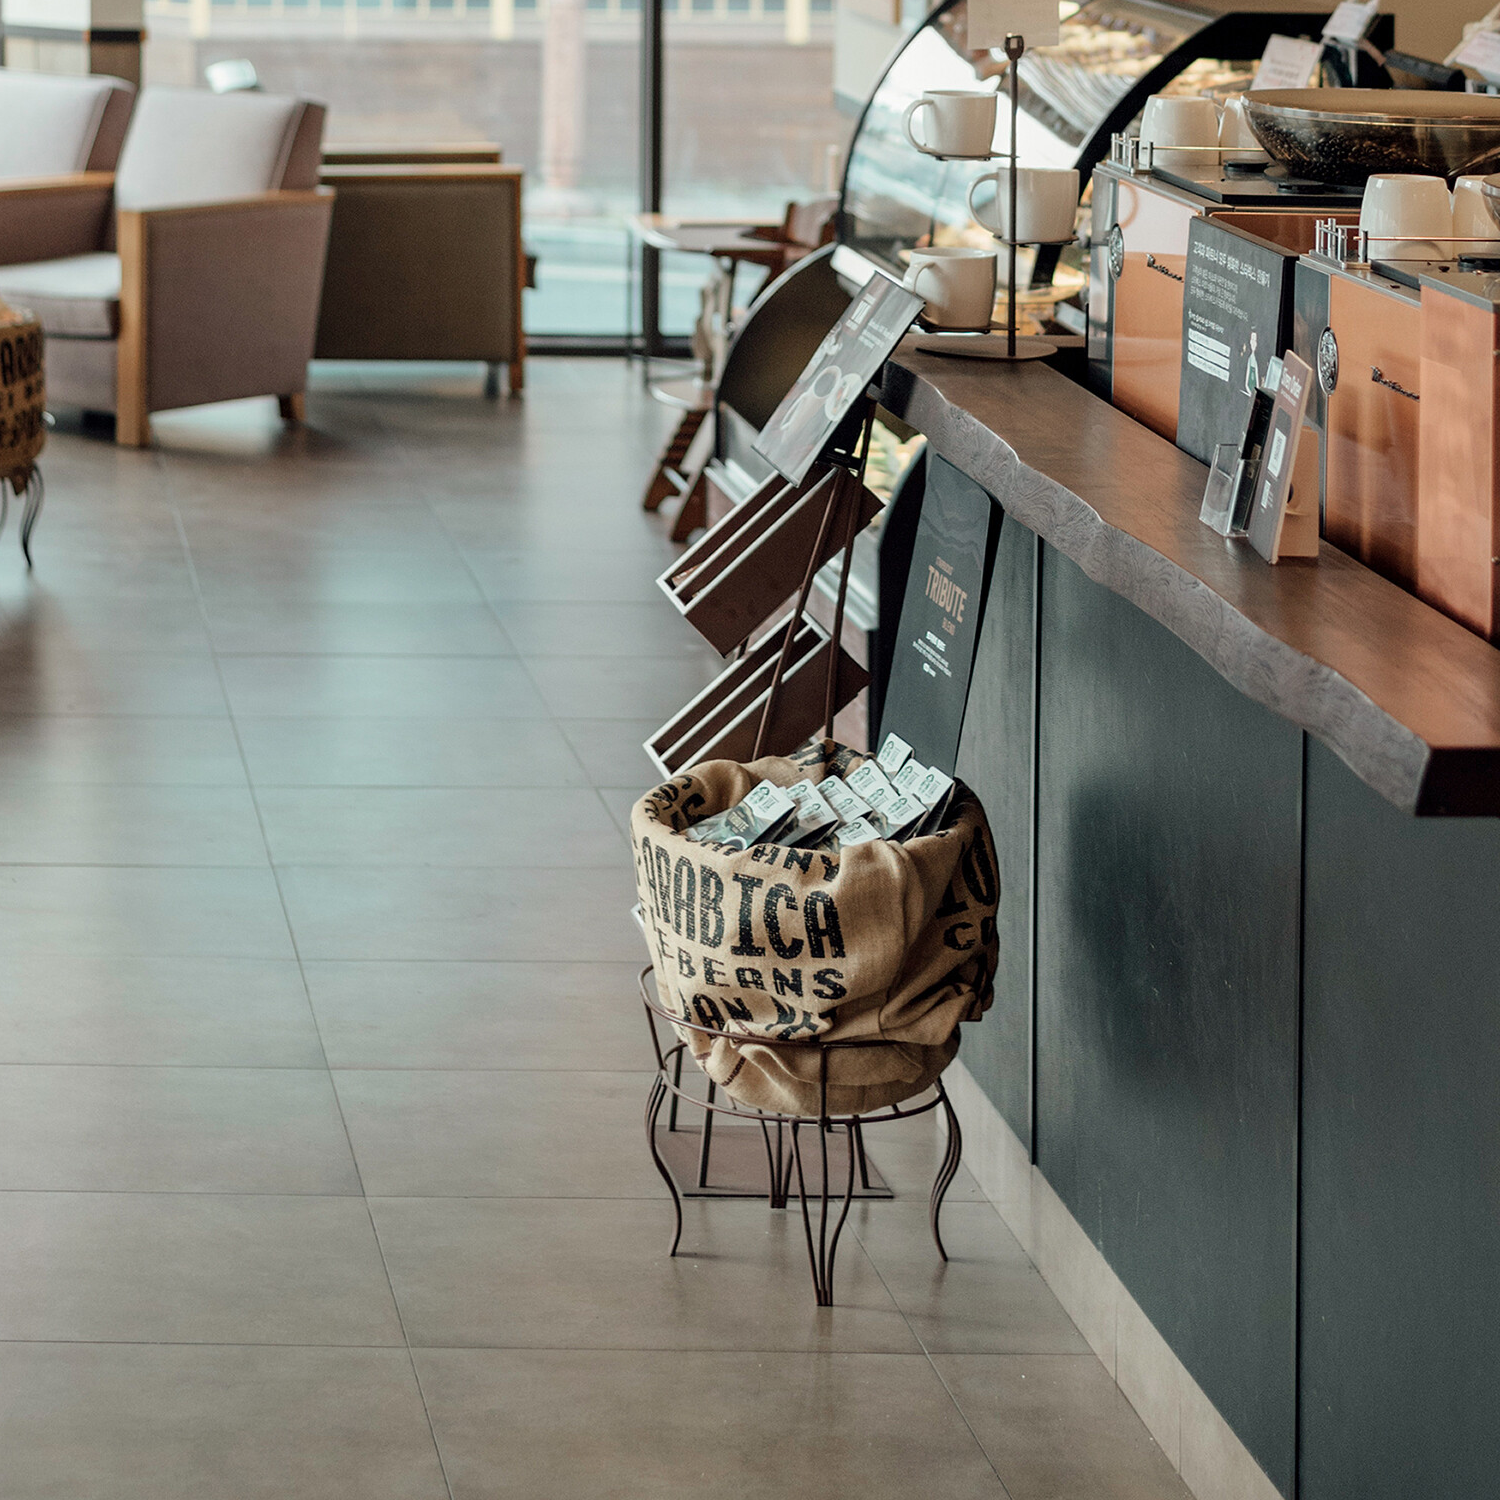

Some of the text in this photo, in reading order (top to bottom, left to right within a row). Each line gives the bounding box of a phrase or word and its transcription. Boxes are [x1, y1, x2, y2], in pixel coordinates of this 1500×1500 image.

[925, 564, 968, 624] TRIBUTE
[640, 835, 847, 961] ARABICA
[677, 945, 848, 1001] BEANS
